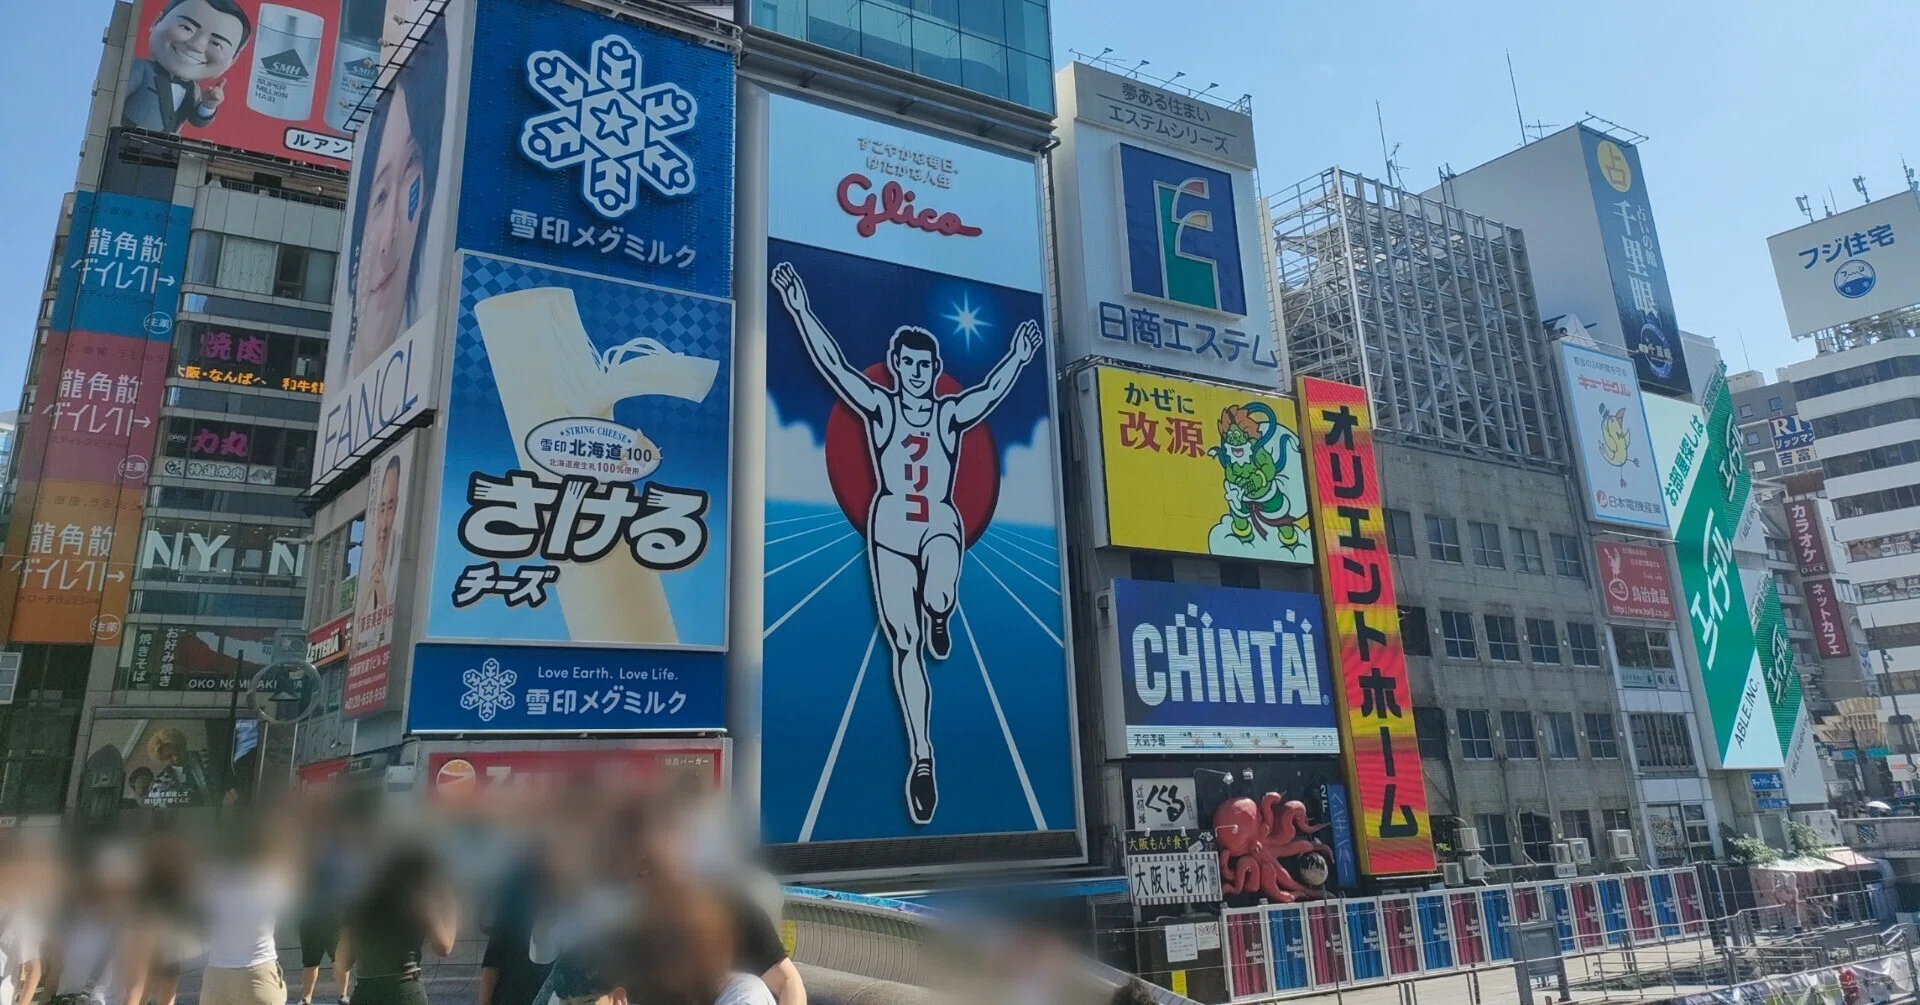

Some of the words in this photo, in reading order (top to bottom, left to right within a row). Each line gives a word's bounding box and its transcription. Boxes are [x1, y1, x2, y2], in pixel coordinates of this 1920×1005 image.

[257, 78, 287, 90] SUPER
[272, 61, 301, 76] SMH
[255, 92, 276, 103] HAIR
[256, 85, 288, 99] MILLION
[1121, 82, 1211, 123] 夢ある住まい
[293, 134, 348, 153] ルアン
[1108, 104, 1229, 154] エステムシリーズ
[866, 156, 951, 189] ゆたかな人生
[1605, 142, 1627, 188] 占
[837, 173, 983, 237] Glico
[88, 227, 167, 264] 龍角散
[509, 209, 697, 271] 雪印メグミルク
[1798, 224, 1895, 269] フジ住宅
[71, 258, 175, 294] ダイレクト
[1613, 199, 1658, 318] 千里眼
[145, 318, 170, 329] 生薬
[1099, 301, 1279, 368] 日商エステム
[201, 332, 265, 364] 焼肉
[60, 369, 143, 404] 龍角散
[1124, 382, 1195, 415] かぜに
[41, 402, 151, 436] ダイレクト
[321, 339, 418, 477] FANCL
[168, 434, 186, 442] OPEN
[192, 428, 248, 457] 力丸
[565, 425, 595, 437] STRING
[597, 426, 628, 442] CHEESE
[1117, 410, 1206, 458] 改源
[1770, 416, 1813, 438] RI
[121, 462, 146, 473] 生薬
[540, 438, 567, 452] 雪印
[568, 438, 622, 461] 北海道
[627, 447, 652, 463] 100
[549, 458, 640, 476] 北海道産生乳100%使用
[1665, 413, 1704, 508] お部屋探しは
[188, 462, 245, 479] 特選焼肉
[901, 431, 931, 523] グリコ
[460, 472, 707, 568] さける
[1792, 504, 1817, 563] カラオケ
[29, 522, 117, 557] 龍角散
[142, 530, 231, 572] NY
[10, 558, 125, 591] ダイレクト
[455, 563, 557, 607] チーズ
[1690, 508, 1734, 670] エイブル
[92, 621, 118, 633] 生薬
[1321, 404, 1418, 840] オリエントホーム
[1812, 582, 1841, 656] ネットカフェ
[132, 633, 153, 682] 焼きそば
[159, 627, 179, 687] お好み焼き
[1132, 602, 1322, 706] CHINTAI
[538, 666, 568, 679] Love
[573, 666, 614, 680] Earth.
[619, 667, 648, 681] Love
[651, 667, 679, 681] Life.
[526, 685, 687, 717] 雪印メグミルク
[1133, 732, 1166, 747] 天気予報
[1320, 784, 1328, 812] 2F
[1128, 834, 1191, 852] 大阪もんを食す
[1135, 861, 1208, 896] 大阪に乾杯
